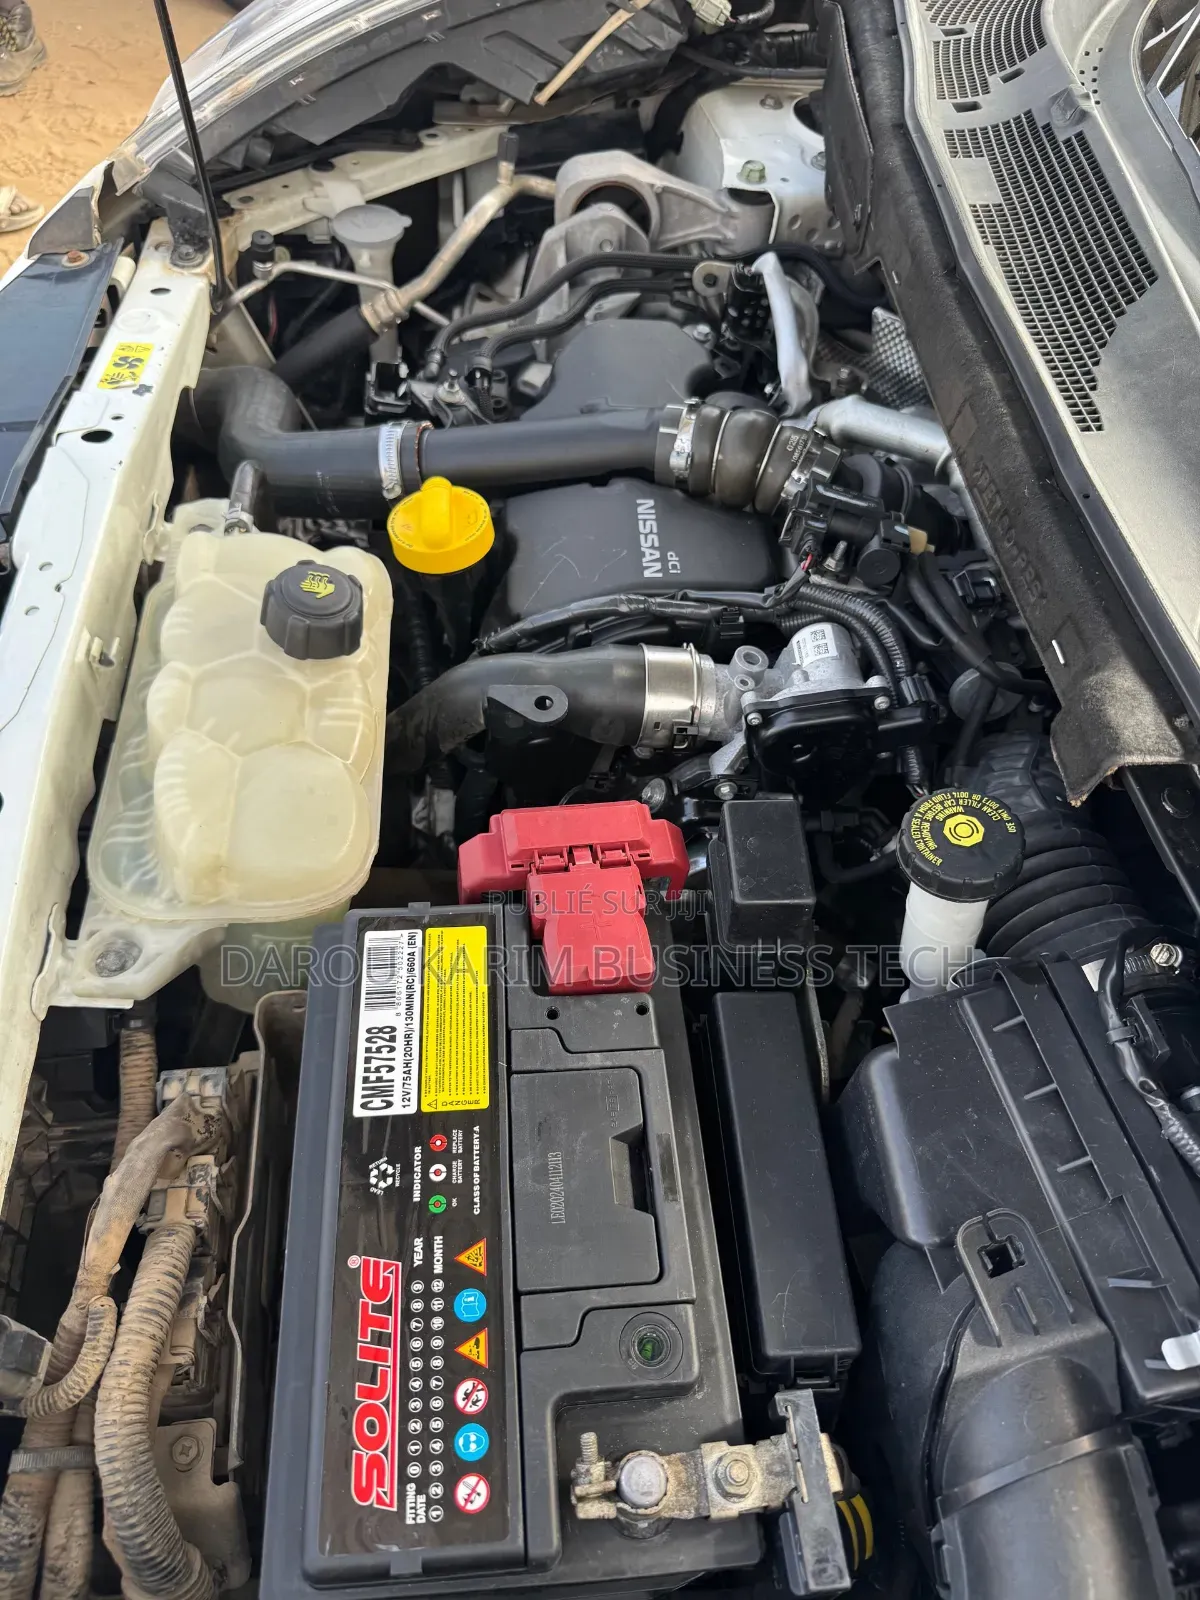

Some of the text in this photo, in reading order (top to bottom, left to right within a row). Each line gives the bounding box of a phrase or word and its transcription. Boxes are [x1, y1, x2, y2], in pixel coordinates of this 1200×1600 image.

[636, 498, 663, 578] NISSAN
[667, 551, 681, 574] dCi
[917, 800, 934, 814] FROM
[932, 792, 951, 803] FLUID
[982, 796, 1000, 810] DOT3
[935, 806, 964, 822] WARNING
[998, 808, 1012, 820] ONLY
[910, 818, 921, 839] SEALED
[920, 798, 1001, 851] CLEAN FILLER CAP BEFORE REMOVING
[1006, 822, 1016, 833] USE
[914, 840, 943, 866] CONTAINER
[408, 931, 418, 950] (EN)
[360, 1025, 397, 1111] CMF57528
[442, 1099, 480, 1108] DANGER
[369, 1156, 387, 1169] RETURN
[413, 1146, 422, 1202] INDICATOR
[474, 1173, 480, 1184] OF
[370, 1187, 384, 1195] LEAD
[452, 1197, 458, 1207] OK
[414, 1237, 423, 1268] YEAR
[434, 1236, 443, 1274] MONTH
[351, 1256, 402, 1512] SOLITE
[406, 1483, 416, 1525] FITTING
[416, 1494, 426, 1524] DATE
